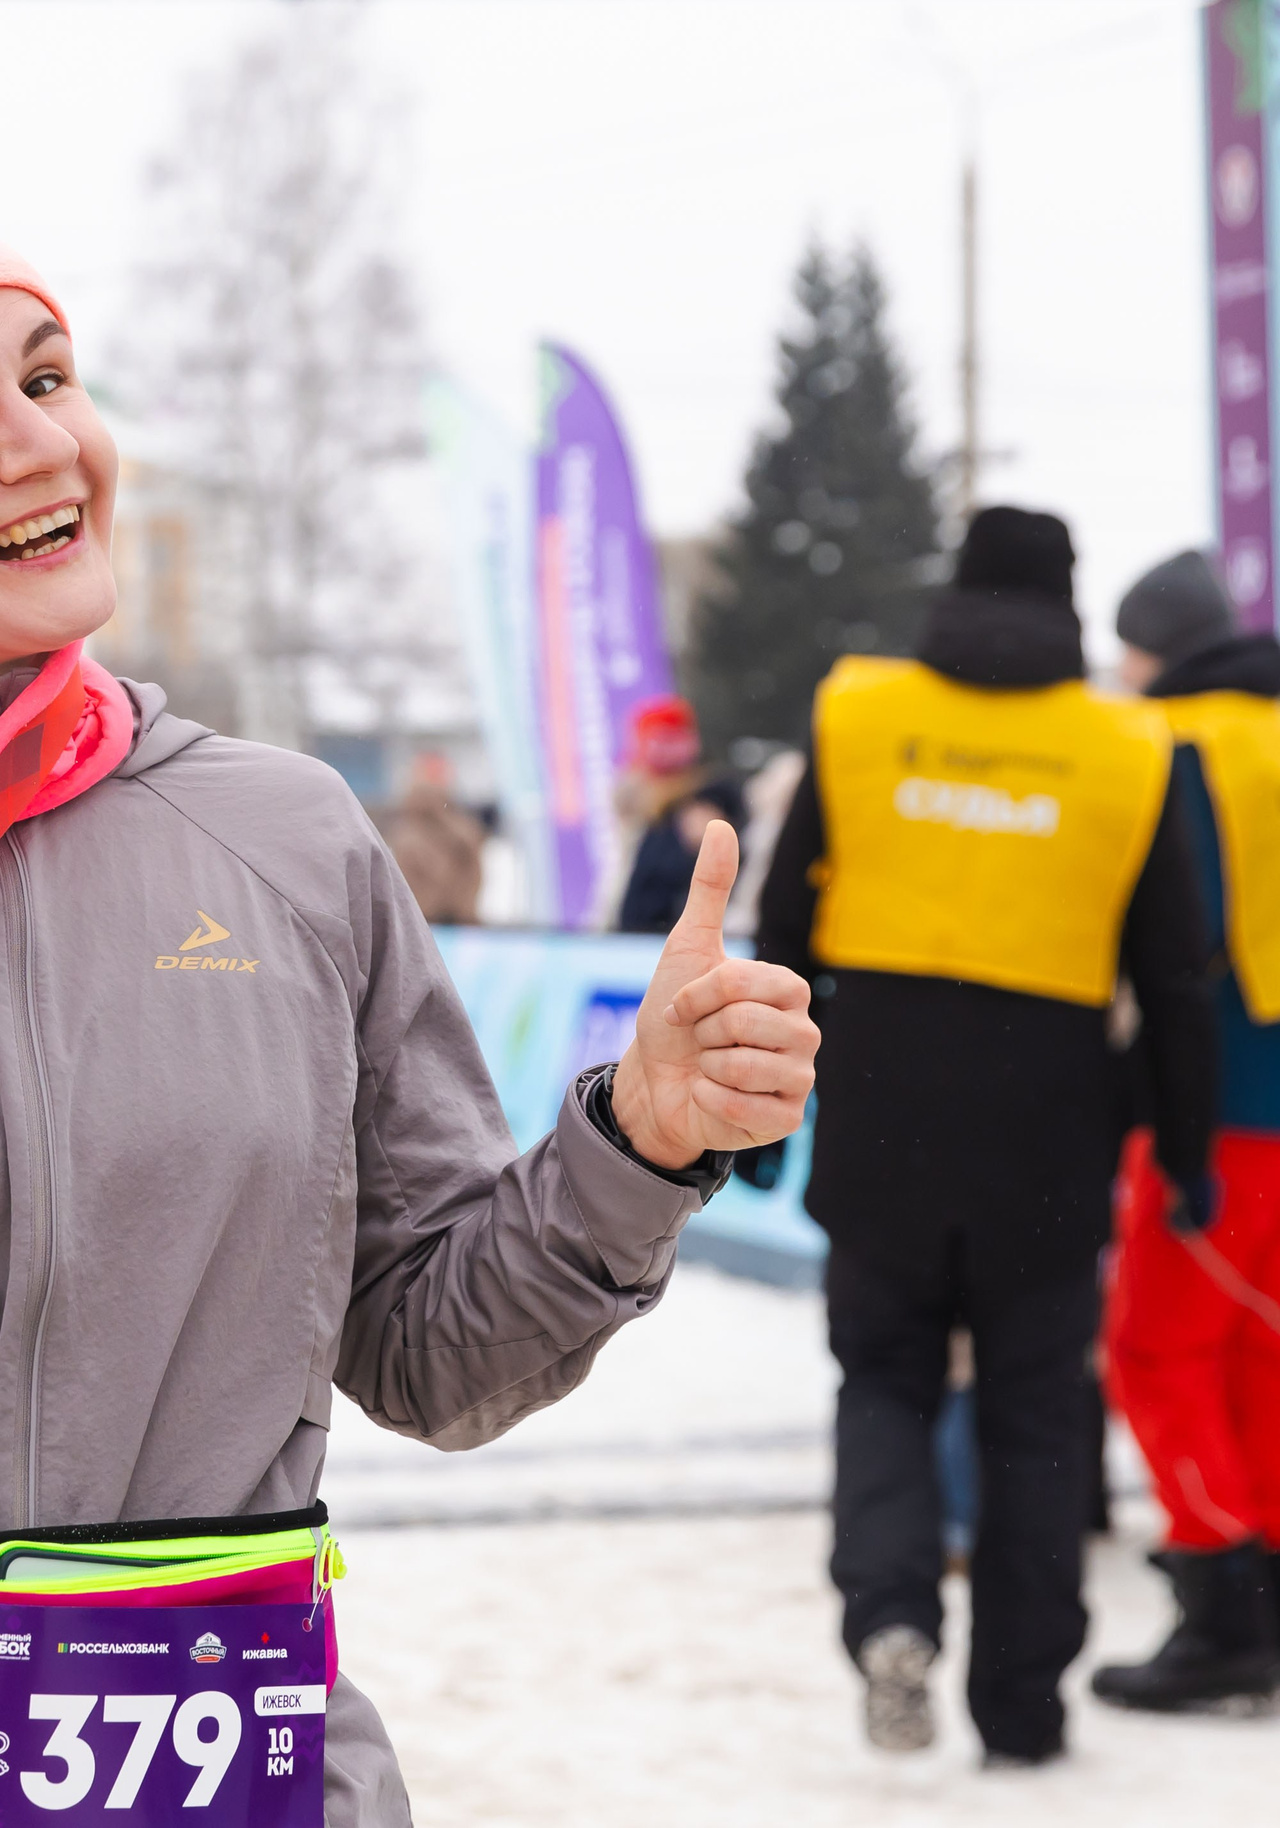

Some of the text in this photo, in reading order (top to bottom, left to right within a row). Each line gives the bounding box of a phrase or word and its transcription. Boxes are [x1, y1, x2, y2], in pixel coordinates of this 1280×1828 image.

[154, 955, 261, 973] DEMIX
[69, 1642, 170, 1654] РОССЕЛЬХОЗБАНК
[242, 1648, 288, 1660] ижавиа
[262, 1694, 302, 1709] ИЖЕВСК
[268, 1727, 293, 1754] 10
[20, 1691, 242, 1810] 379
[267, 1755, 294, 1776] КМ
